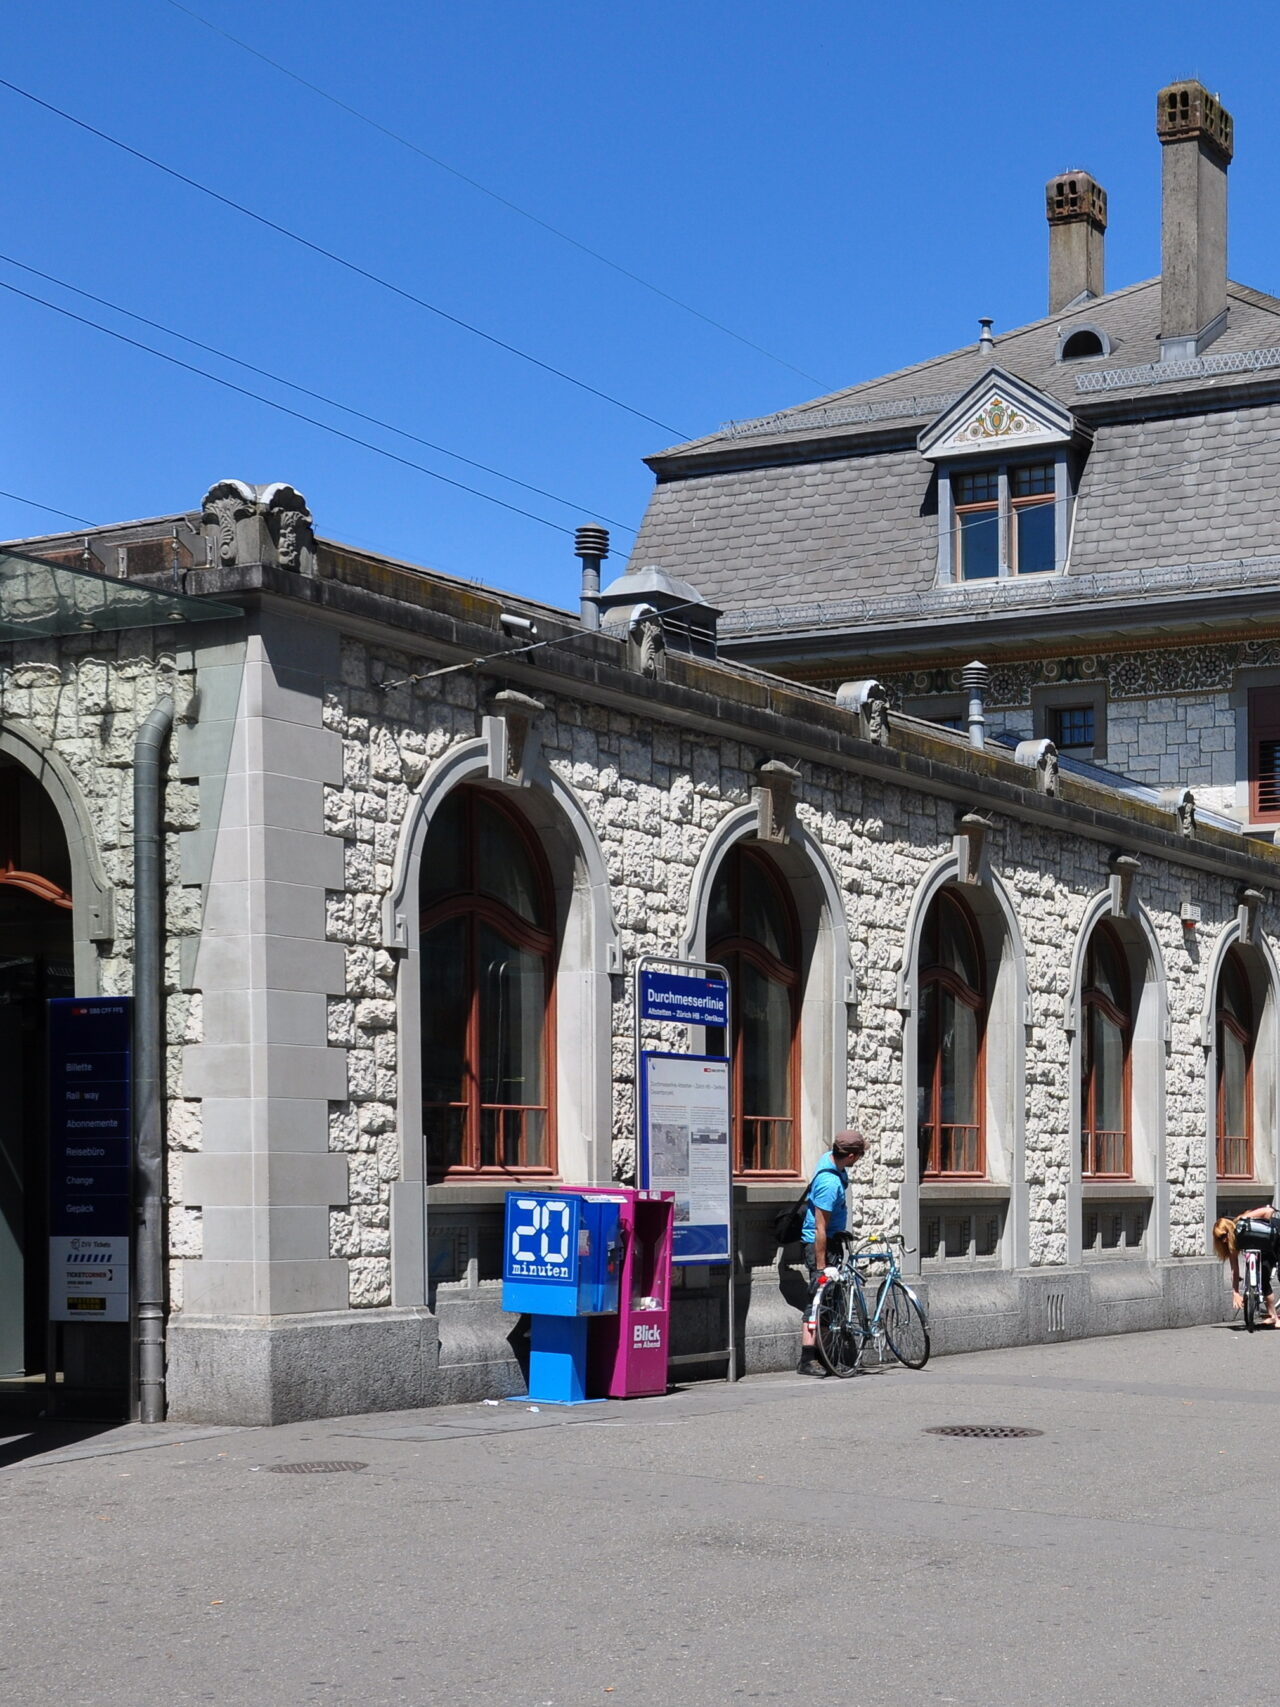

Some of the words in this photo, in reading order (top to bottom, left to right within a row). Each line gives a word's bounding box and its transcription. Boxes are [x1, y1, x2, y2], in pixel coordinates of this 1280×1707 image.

[647, 988, 724, 1011] Durchmesserlinie
[647, 1007, 672, 1017] Altstetten
[676, 1009, 692, 1019] Zürich
[692, 1012, 700, 1020] HB
[704, 1013, 725, 1023] Oerlikon
[66, 1063, 92, 1072] Billette
[66, 1119, 118, 1128] Abonnemente
[66, 1147, 105, 1157] Reisebüro
[66, 1176, 94, 1186] Change
[66, 1204, 94, 1214] Gepäck
[512, 1200, 570, 1263] 20
[512, 1262, 569, 1278] minuten
[633, 1324, 661, 1342] Blick
[643, 1340, 660, 1348] Abend
